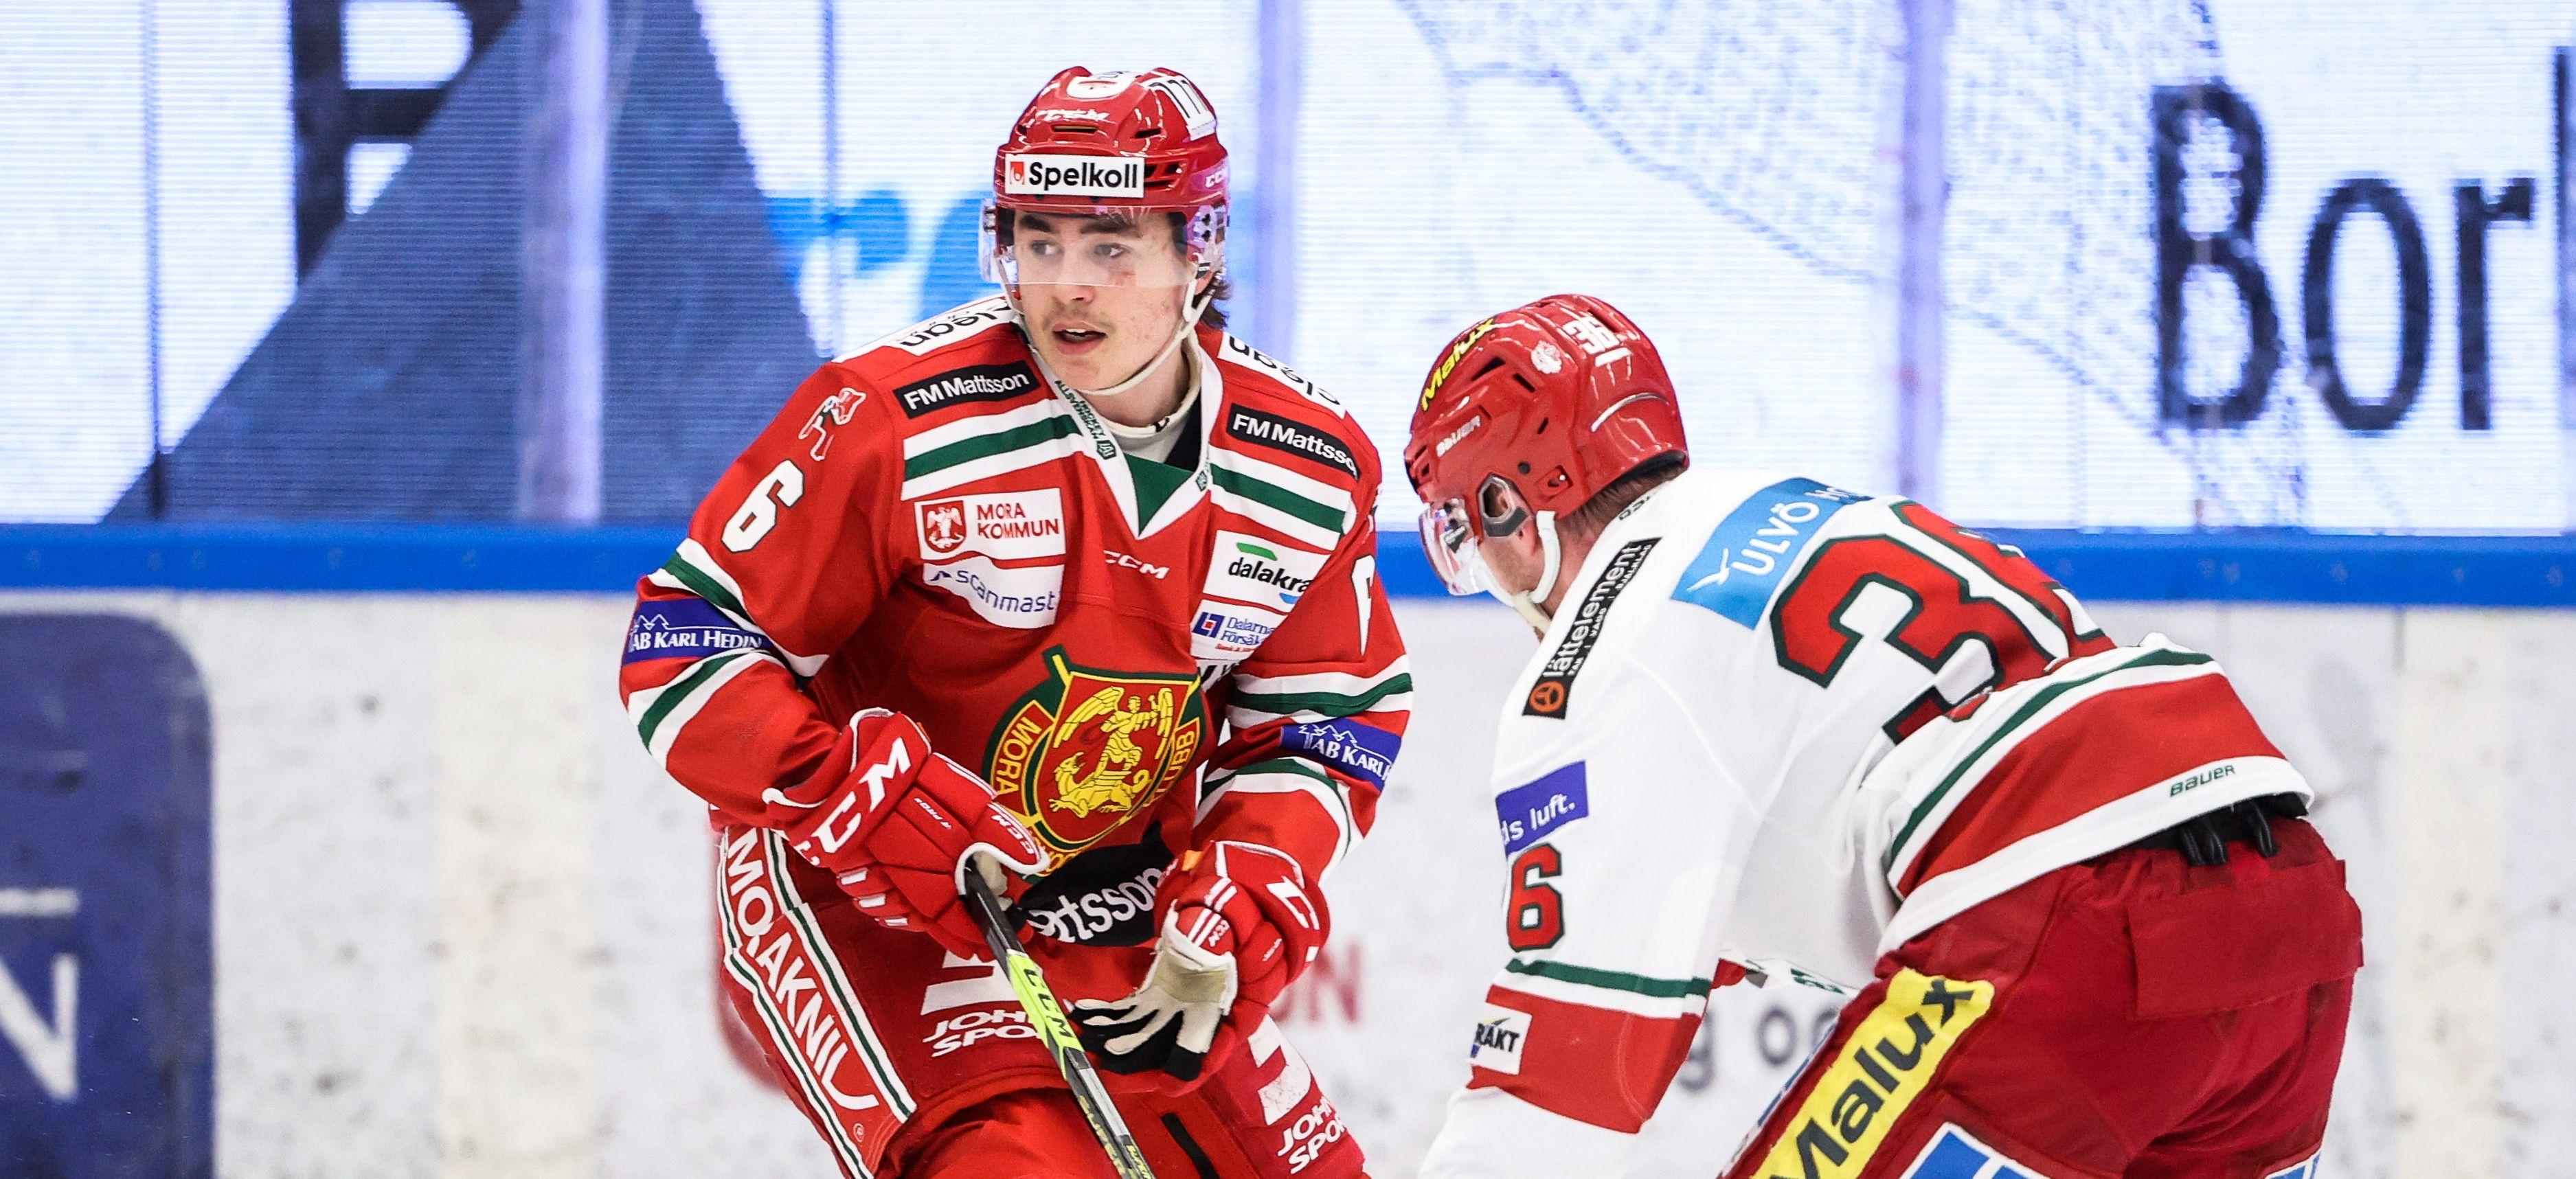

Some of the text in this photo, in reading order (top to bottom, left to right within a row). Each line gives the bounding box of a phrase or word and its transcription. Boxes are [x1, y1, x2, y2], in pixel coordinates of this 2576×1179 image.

[1030, 162, 1138, 191] Spelkoll
[903, 373, 1030, 411] FM Mattsson
[1421, 318, 1495, 412] Malux
[1232, 413, 1272, 438] FM
[720, 459, 805, 553] 6
[976, 503, 1026, 520] MORA
[978, 518, 1059, 539] KOMMUN
[1730, 501, 1820, 577] ULVÖ
[956, 569, 1057, 613] scanmast
[1542, 545, 1642, 677] lättelement
[653, 632, 700, 648] KARL
[1770, 496, 2117, 744] 36
[995, 716, 1043, 794] MORA
[1530, 794, 1575, 827] luft.
[1506, 843, 1566, 953] 6
[1024, 968, 1072, 1038] CCM
[931, 1025, 1046, 1057] SPO
[1767, 979, 1976, 1179] Malux
